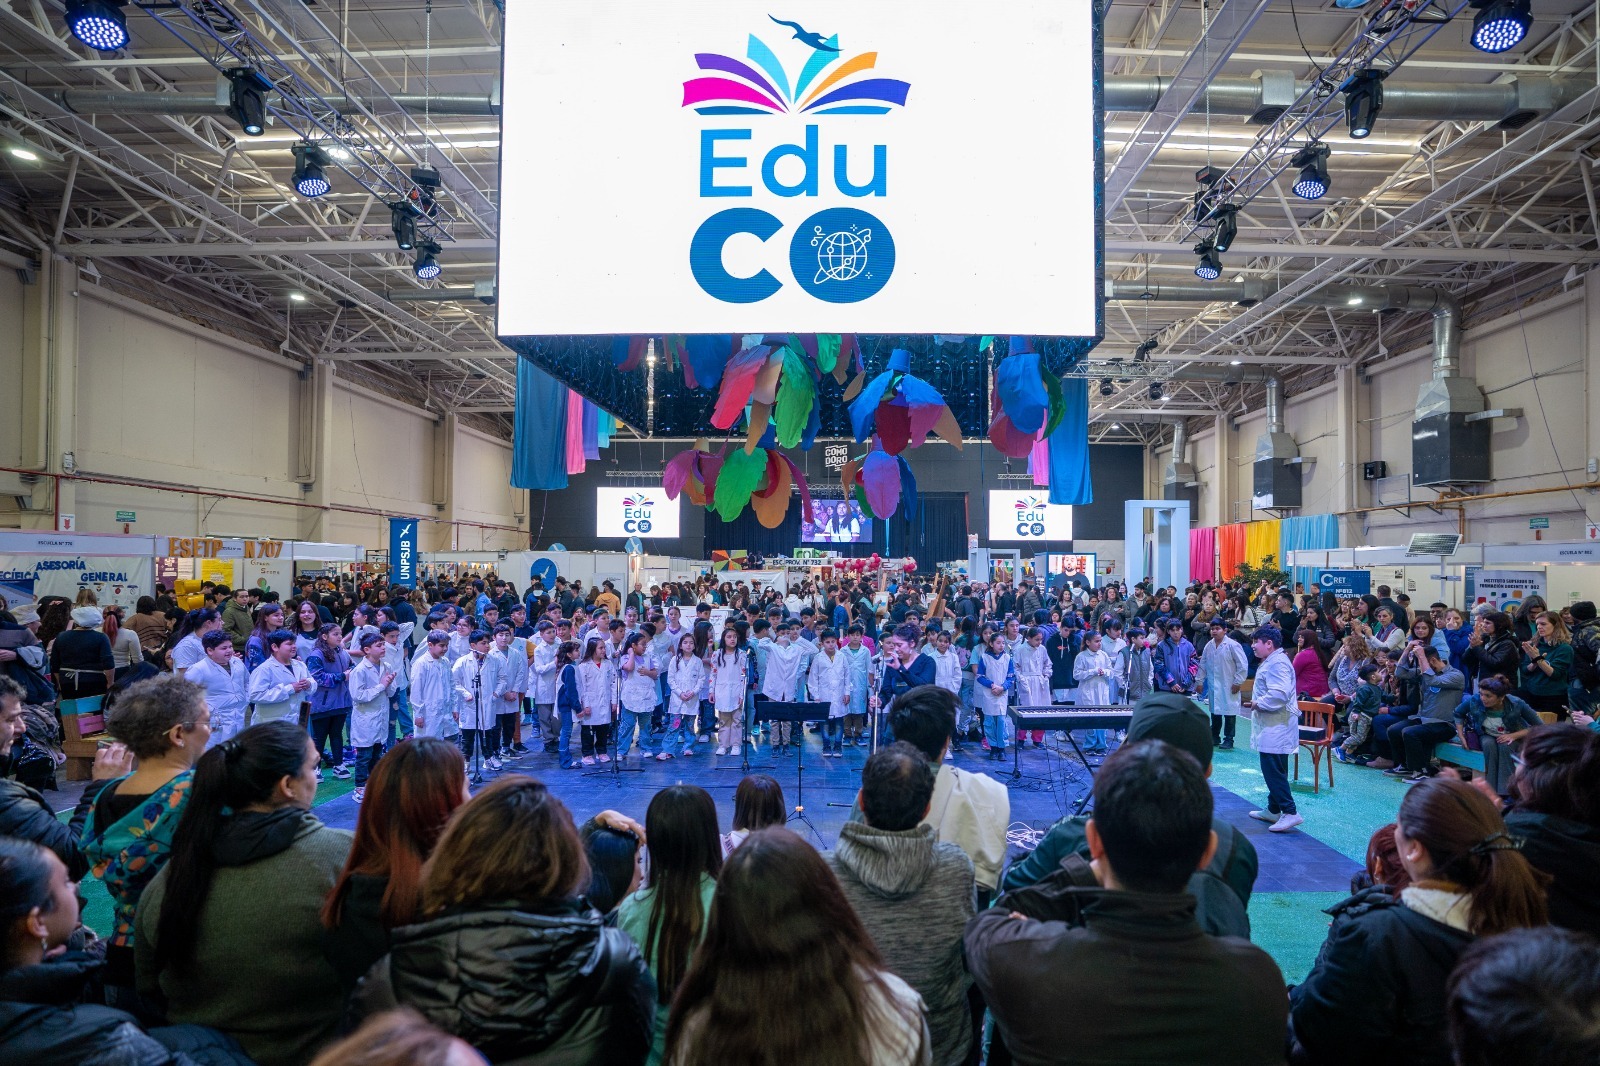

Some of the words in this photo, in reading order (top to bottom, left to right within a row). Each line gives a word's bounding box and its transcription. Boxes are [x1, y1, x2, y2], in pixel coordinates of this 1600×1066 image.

[700, 125, 887, 197] Edu
[690, 207, 896, 304] CO
[825, 447, 848, 456] COMO
[825, 455, 848, 465] DORO
[624, 508, 651, 519] Edu
[1017, 510, 1044, 522] Edu
[623, 519, 652, 533] CO
[1016, 522, 1045, 537] CO
[168, 537, 223, 558] ESETP
[257, 541, 284, 558] 707
[36, 556, 86, 571] ASESORÍA
[400, 540, 411, 580] UNPSJB
[81, 571, 128, 582] GENERAL
